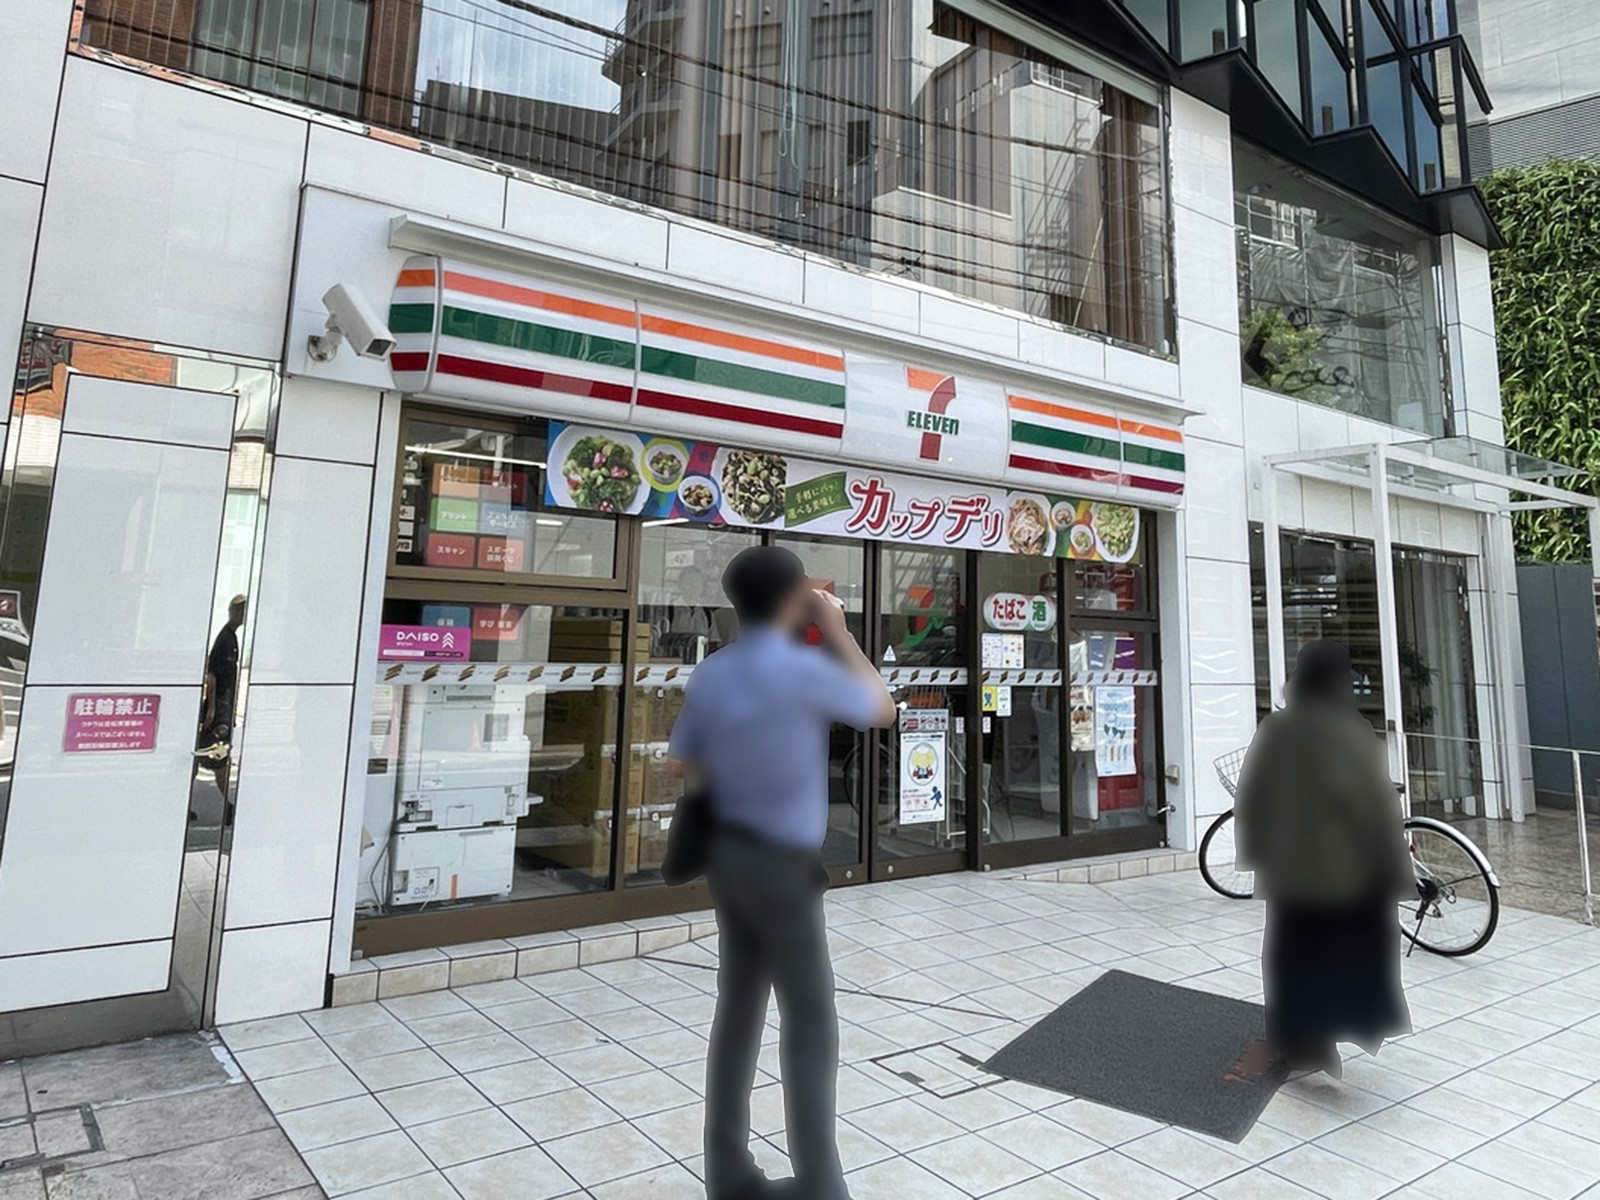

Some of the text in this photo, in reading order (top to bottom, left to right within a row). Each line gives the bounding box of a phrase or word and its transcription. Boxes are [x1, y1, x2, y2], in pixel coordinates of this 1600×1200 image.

[907, 366, 957, 461] 7
[441, 511, 467, 520] プリント
[848, 479, 1003, 544] カップデリ
[437, 545, 467, 556] スキャン
[992, 598, 1047, 622] たばこ 酒
[396, 631, 440, 642] DAISO
[74, 698, 152, 716] 駐輪禁止
